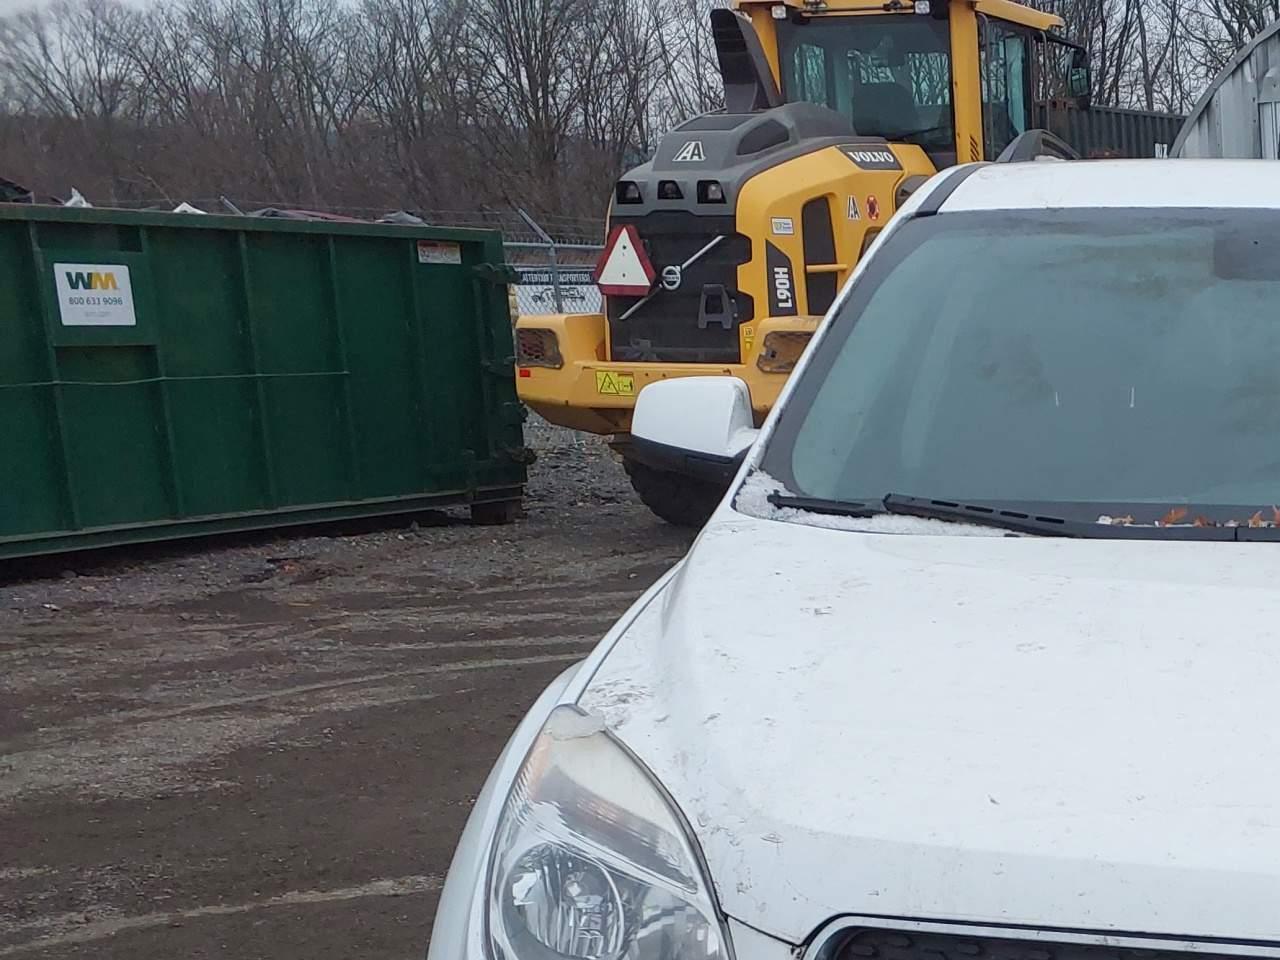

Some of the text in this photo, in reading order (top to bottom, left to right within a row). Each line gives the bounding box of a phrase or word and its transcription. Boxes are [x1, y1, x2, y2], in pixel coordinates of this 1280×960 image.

[848, 151, 894, 162] VOLVO
[65, 271, 118, 290] WM
[774, 267, 793, 308] L90H
